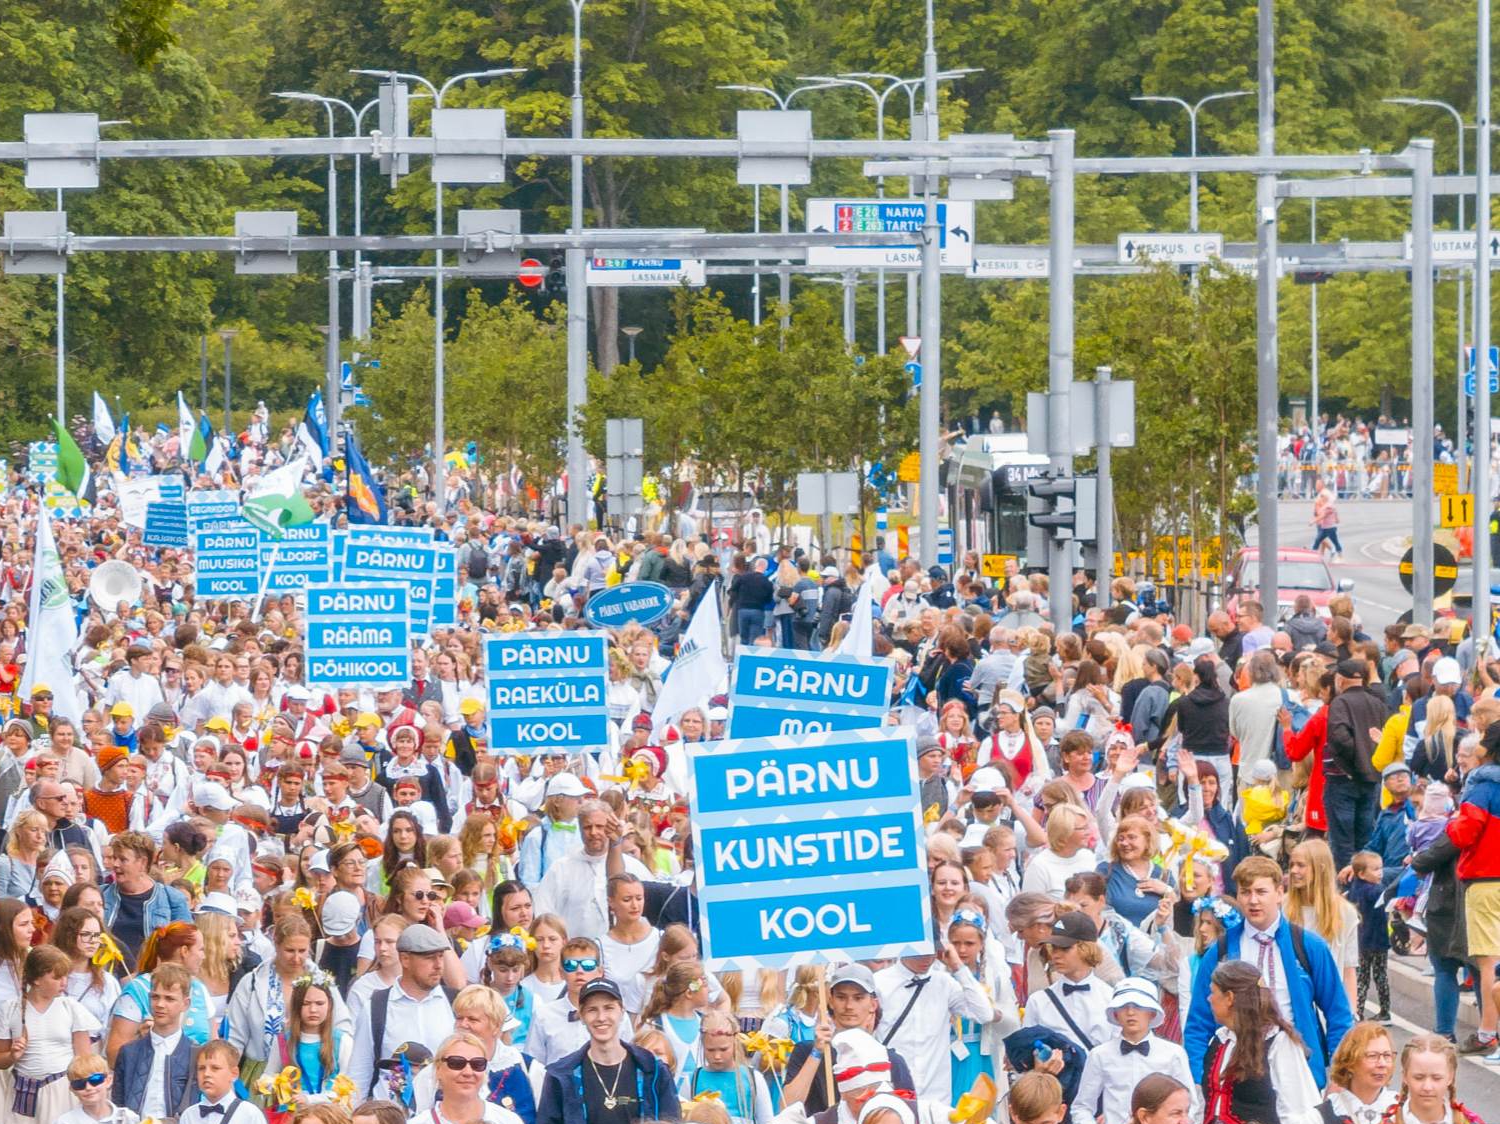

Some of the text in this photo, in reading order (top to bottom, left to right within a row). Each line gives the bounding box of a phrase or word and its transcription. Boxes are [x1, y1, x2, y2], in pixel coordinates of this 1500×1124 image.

[886, 207, 924, 218] NARVA
[886, 221, 923, 231] TARTU
[205, 533, 256, 549] PÄRNU
[355, 549, 425, 570] PÄRNU
[211, 580, 248, 592] KOOL
[319, 592, 395, 612] PÄRNU
[322, 626, 392, 645] RÄÄMA
[501, 643, 590, 667] PÄRNU
[312, 657, 403, 677] PÕHIKOOL
[754, 664, 869, 699] PÄRNU
[496, 681, 600, 705] RAEKÜLA
[517, 721, 581, 742] KOOL
[725, 758, 880, 800] PÄRNU
[713, 826, 905, 872] KUNSTIDE
[759, 902, 872, 941] KOOL
